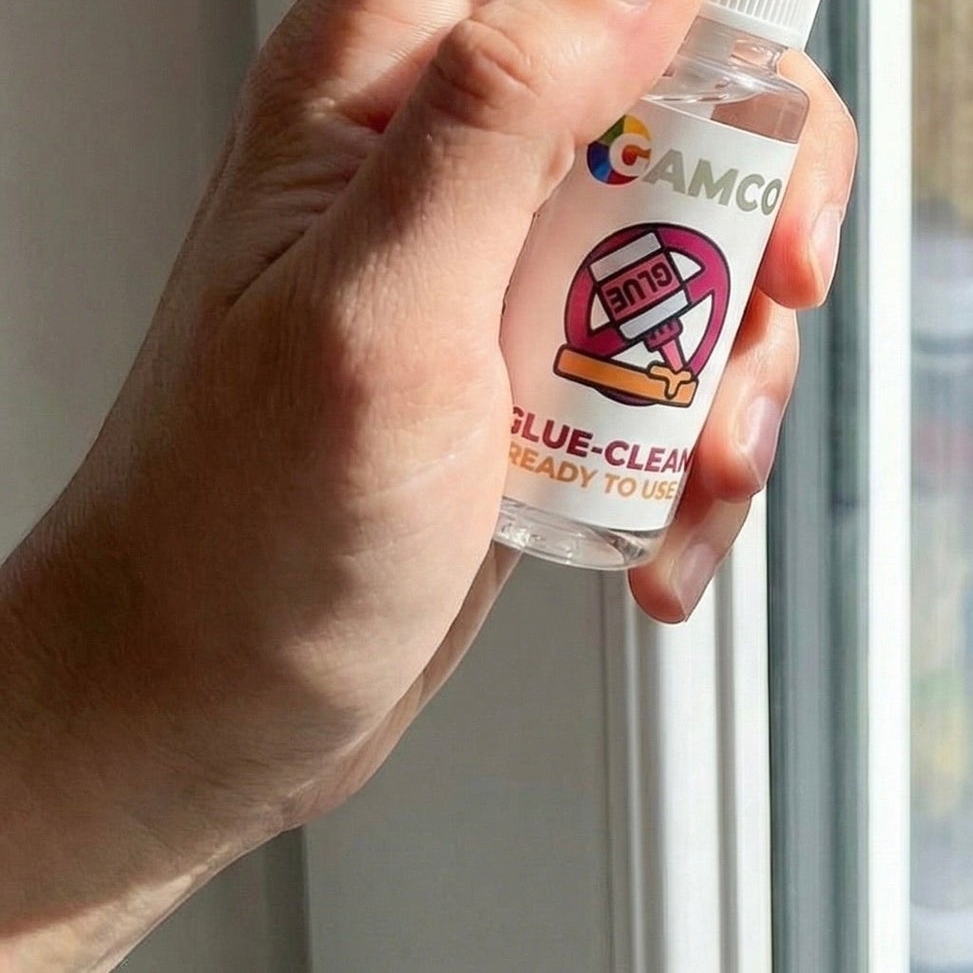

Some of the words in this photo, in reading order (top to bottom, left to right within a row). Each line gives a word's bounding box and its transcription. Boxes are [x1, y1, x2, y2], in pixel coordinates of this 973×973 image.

[605, 262, 672, 314] GLUE
[605, 473, 637, 497] TO
[641, 479, 678, 500] USE
